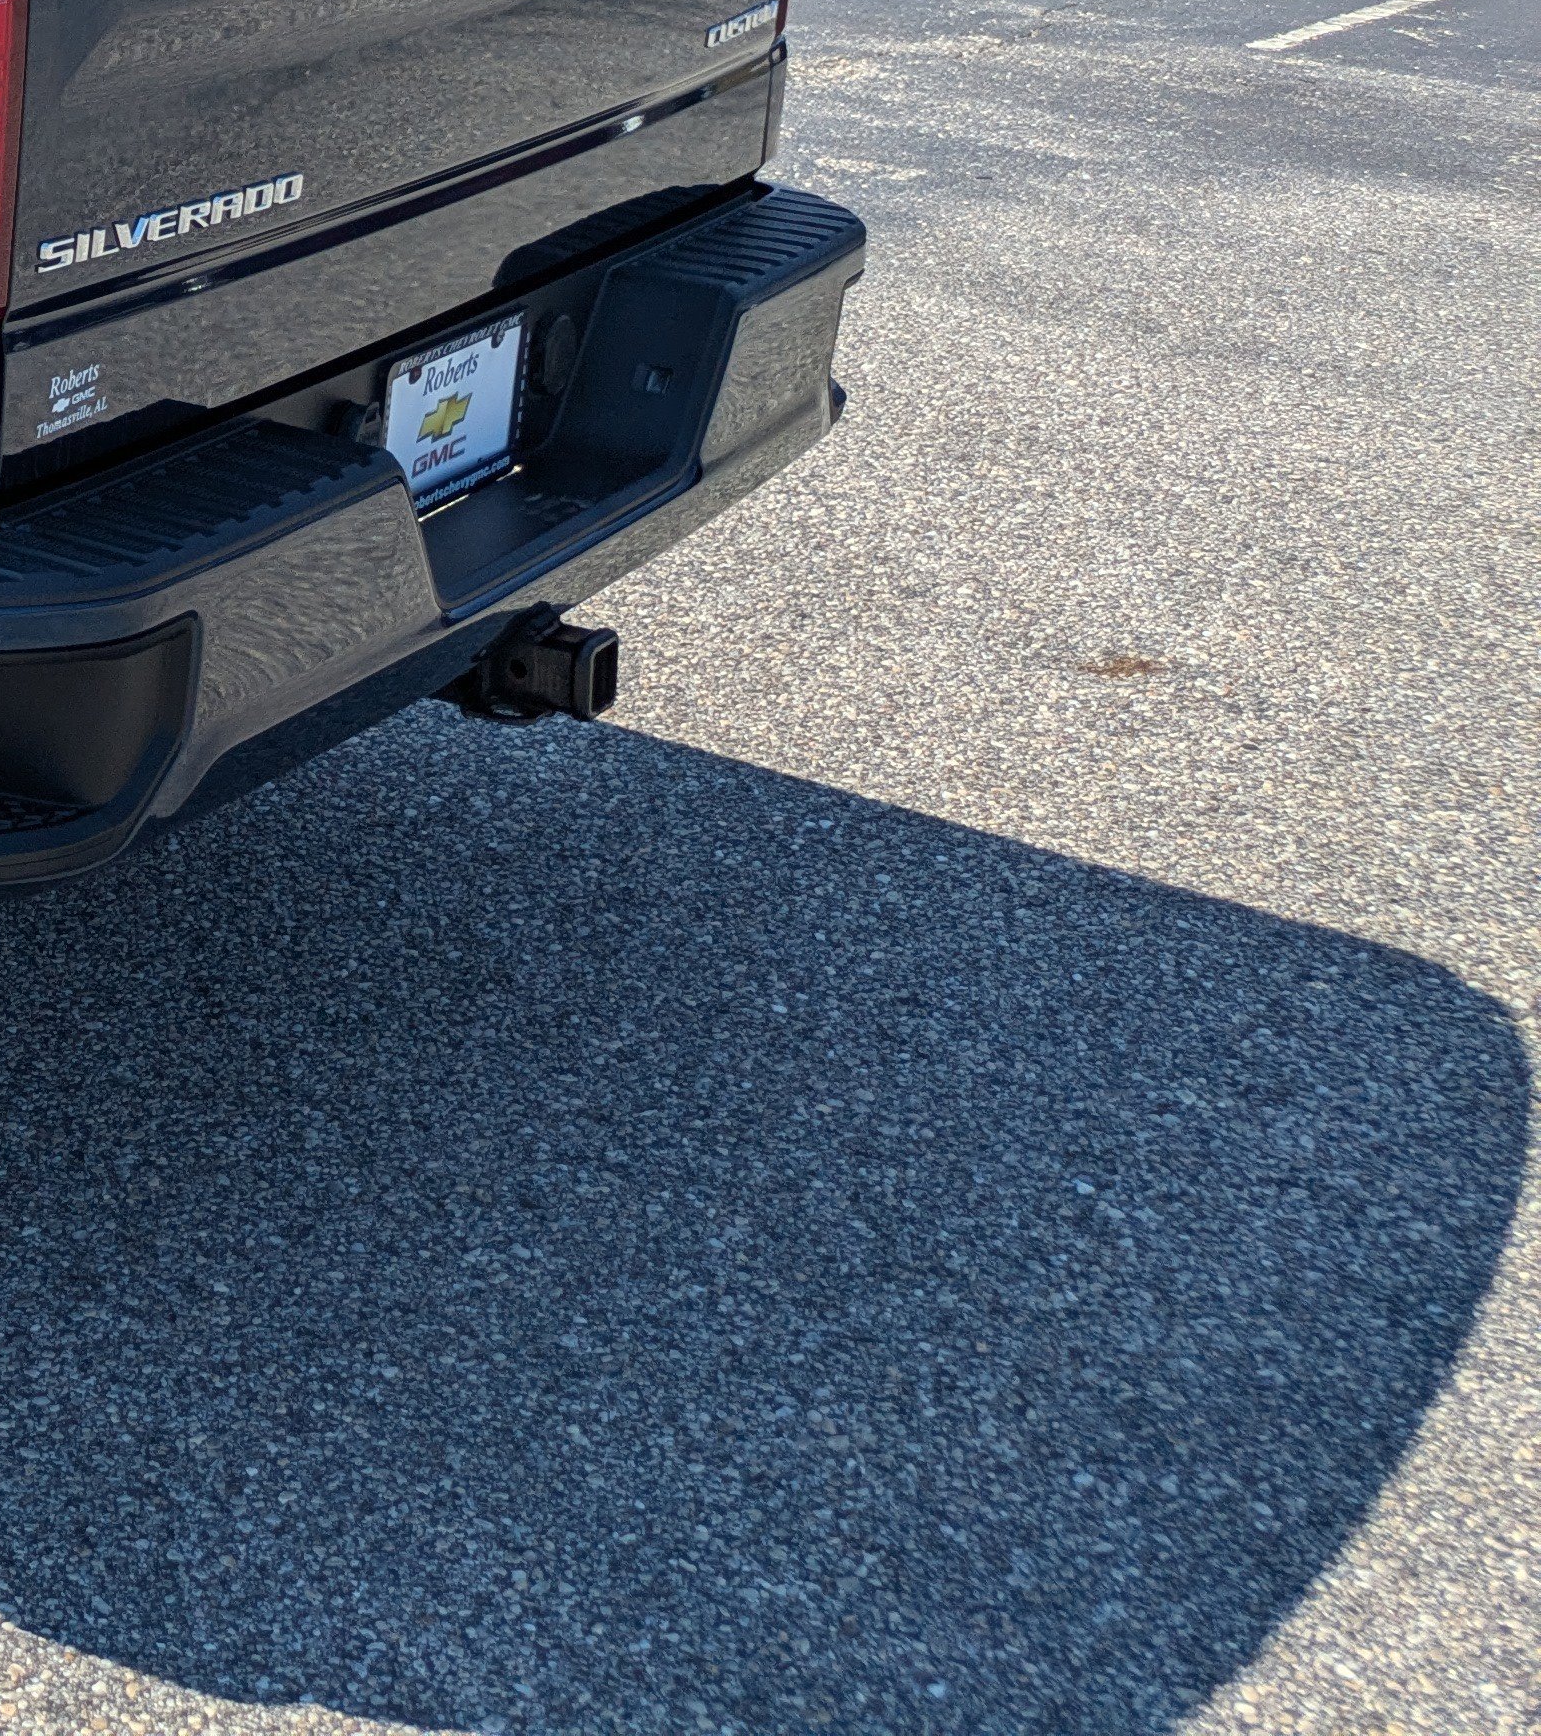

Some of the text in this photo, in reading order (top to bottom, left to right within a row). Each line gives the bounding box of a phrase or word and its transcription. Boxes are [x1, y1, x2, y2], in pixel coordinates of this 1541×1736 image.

[36, 172, 304, 274] SILVERADO
[48, 363, 100, 399] Roberts
[423, 351, 480, 397] Roberts
[71, 385, 96, 405] GMC
[93, 396, 108, 415] AL
[411, 436, 468, 480] GMC
